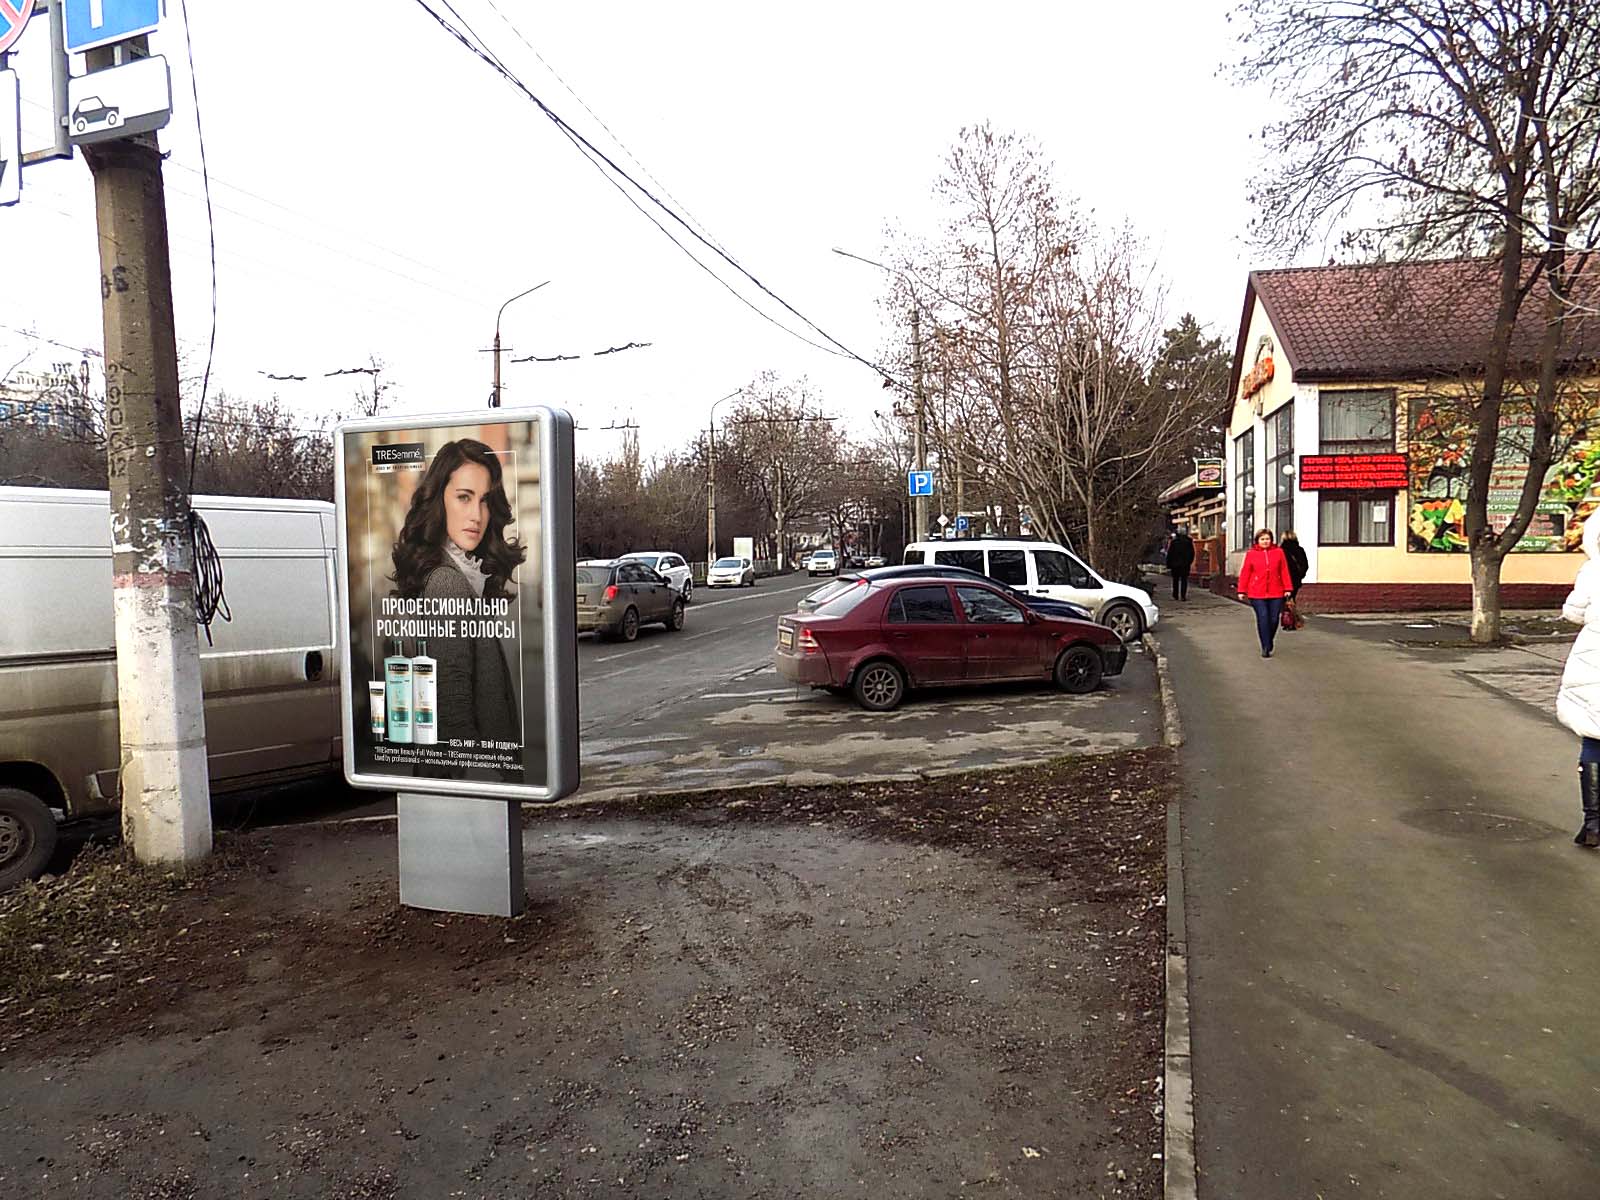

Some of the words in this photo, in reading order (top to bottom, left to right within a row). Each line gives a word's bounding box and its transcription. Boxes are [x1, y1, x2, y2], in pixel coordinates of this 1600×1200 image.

[375, 448, 420, 460] TRESemmé
[915, 474, 928, 493] P
[381, 597, 509, 617] ПРОФЕССИОНАЛЬНО
[376, 619, 457, 638] РОСКОШНЫЕ
[460, 620, 516, 639] ВОЛОСЫ
